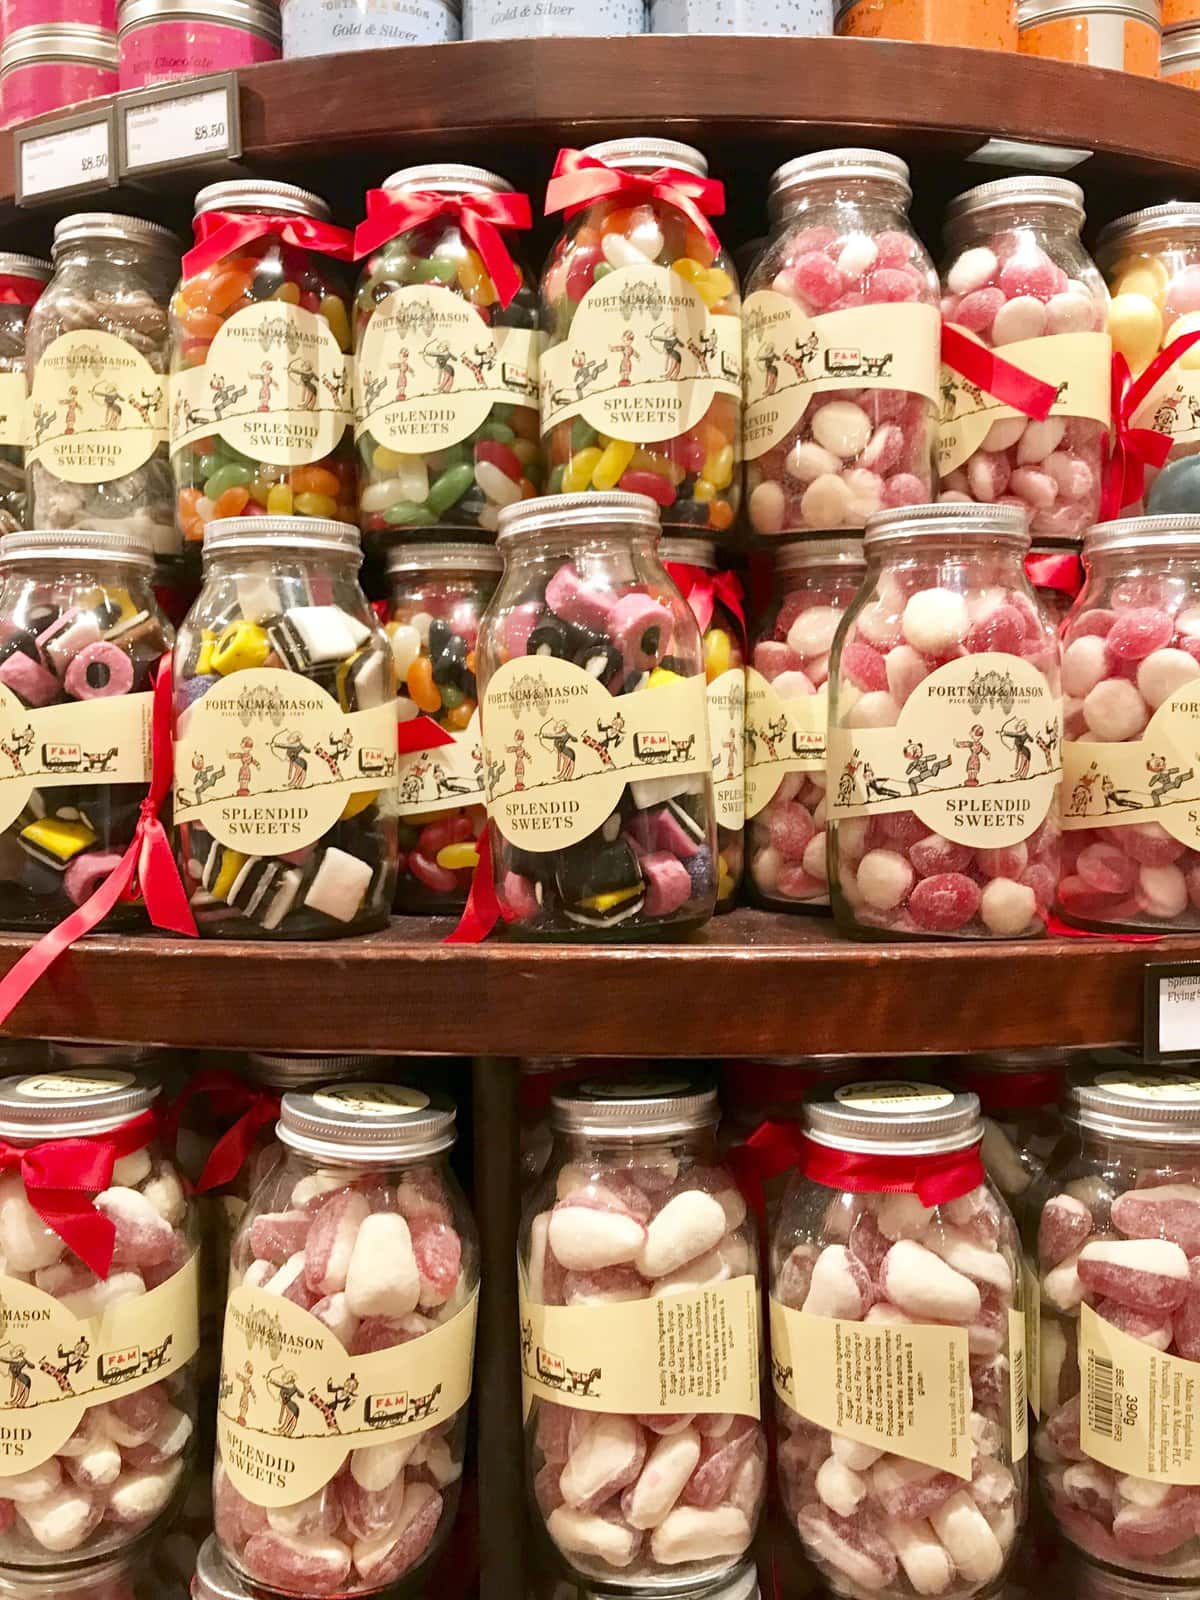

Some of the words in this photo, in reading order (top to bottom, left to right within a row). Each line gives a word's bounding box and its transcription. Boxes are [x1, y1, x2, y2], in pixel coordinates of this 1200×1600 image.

[534, 2, 575, 16] Silver
[332, 23, 361, 38] Gold
[365, 24, 377, 36] &
[380, 24, 419, 41] Silver
[195, 122, 225, 141] £8.50
[81, 153, 107, 172] £8.50
[588, 295, 645, 309] FORTNUM
[657, 296, 695, 309] MASON
[372, 312, 417, 331] FORTNUM
[430, 311, 470, 324] MASON
[295, 331, 329, 346] MASON
[100, 356, 137, 368] MASON
[604, 397, 682, 411] SPLENDID
[384, 409, 456, 425] SPLENDID
[610, 410, 677, 424] SWEETS
[243, 422, 319, 438] SPLENDID
[389, 423, 450, 437] SWEETS
[250, 435, 314, 449] SWEETS
[53, 444, 122, 456] SPLENDID
[58, 455, 116, 466] SWEETS
[488, 689, 531, 705] FORTNUM
[533, 690, 543, 702] &
[544, 683, 589, 699] MASON
[928, 685, 996, 697] FORTNUM
[1010, 686, 1044, 697] MASON
[205, 699, 265, 711] FORTNUM
[267, 698, 276, 711] &
[279, 699, 324, 711] MASON
[642, 735, 667, 745] F&M
[799, 735, 823, 744] F&M
[51, 746, 79, 756] F&M
[506, 800, 580, 816] SPLENDID
[946, 799, 1031, 812] SPLENDID
[222, 808, 308, 820] SPLENDID
[954, 814, 1025, 827] SWEETS
[228, 822, 301, 835] SWEETS
[511, 816, 574, 831] SWEETS
[1168, 991, 1195, 1003] Flying
[2, 1308, 51, 1321] MASON
[266, 1327, 276, 1340] &
[278, 1331, 324, 1351] MASON
[108, 1351, 137, 1366] F&M
[376, 1396, 405, 1409] F&M
[1123, 1395, 1138, 1426] 390g
[1174, 1408, 1182, 1416] &
[227, 1430, 296, 1473] SPLENDID
[1172, 1448, 1181, 1467] PLC
[228, 1449, 287, 1489] SWEETS
